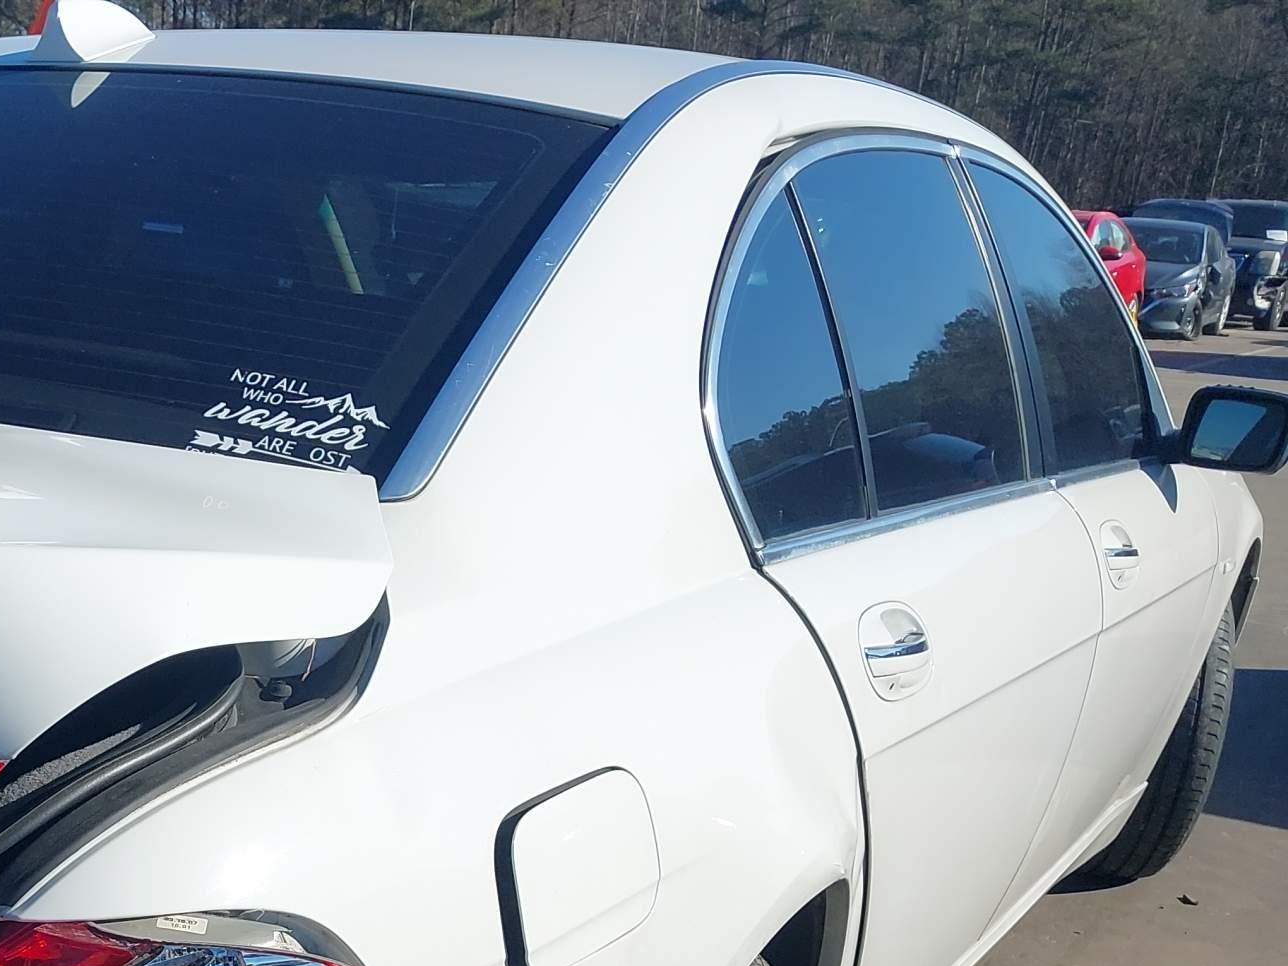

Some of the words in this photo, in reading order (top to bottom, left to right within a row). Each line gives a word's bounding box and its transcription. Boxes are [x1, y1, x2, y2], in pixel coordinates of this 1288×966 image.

[230, 368, 275, 388] NOT
[276, 379, 309, 396] ALL
[242, 387, 283, 405] WHO
[203, 402, 368, 451] wander
[255, 436, 297, 455] ARE
